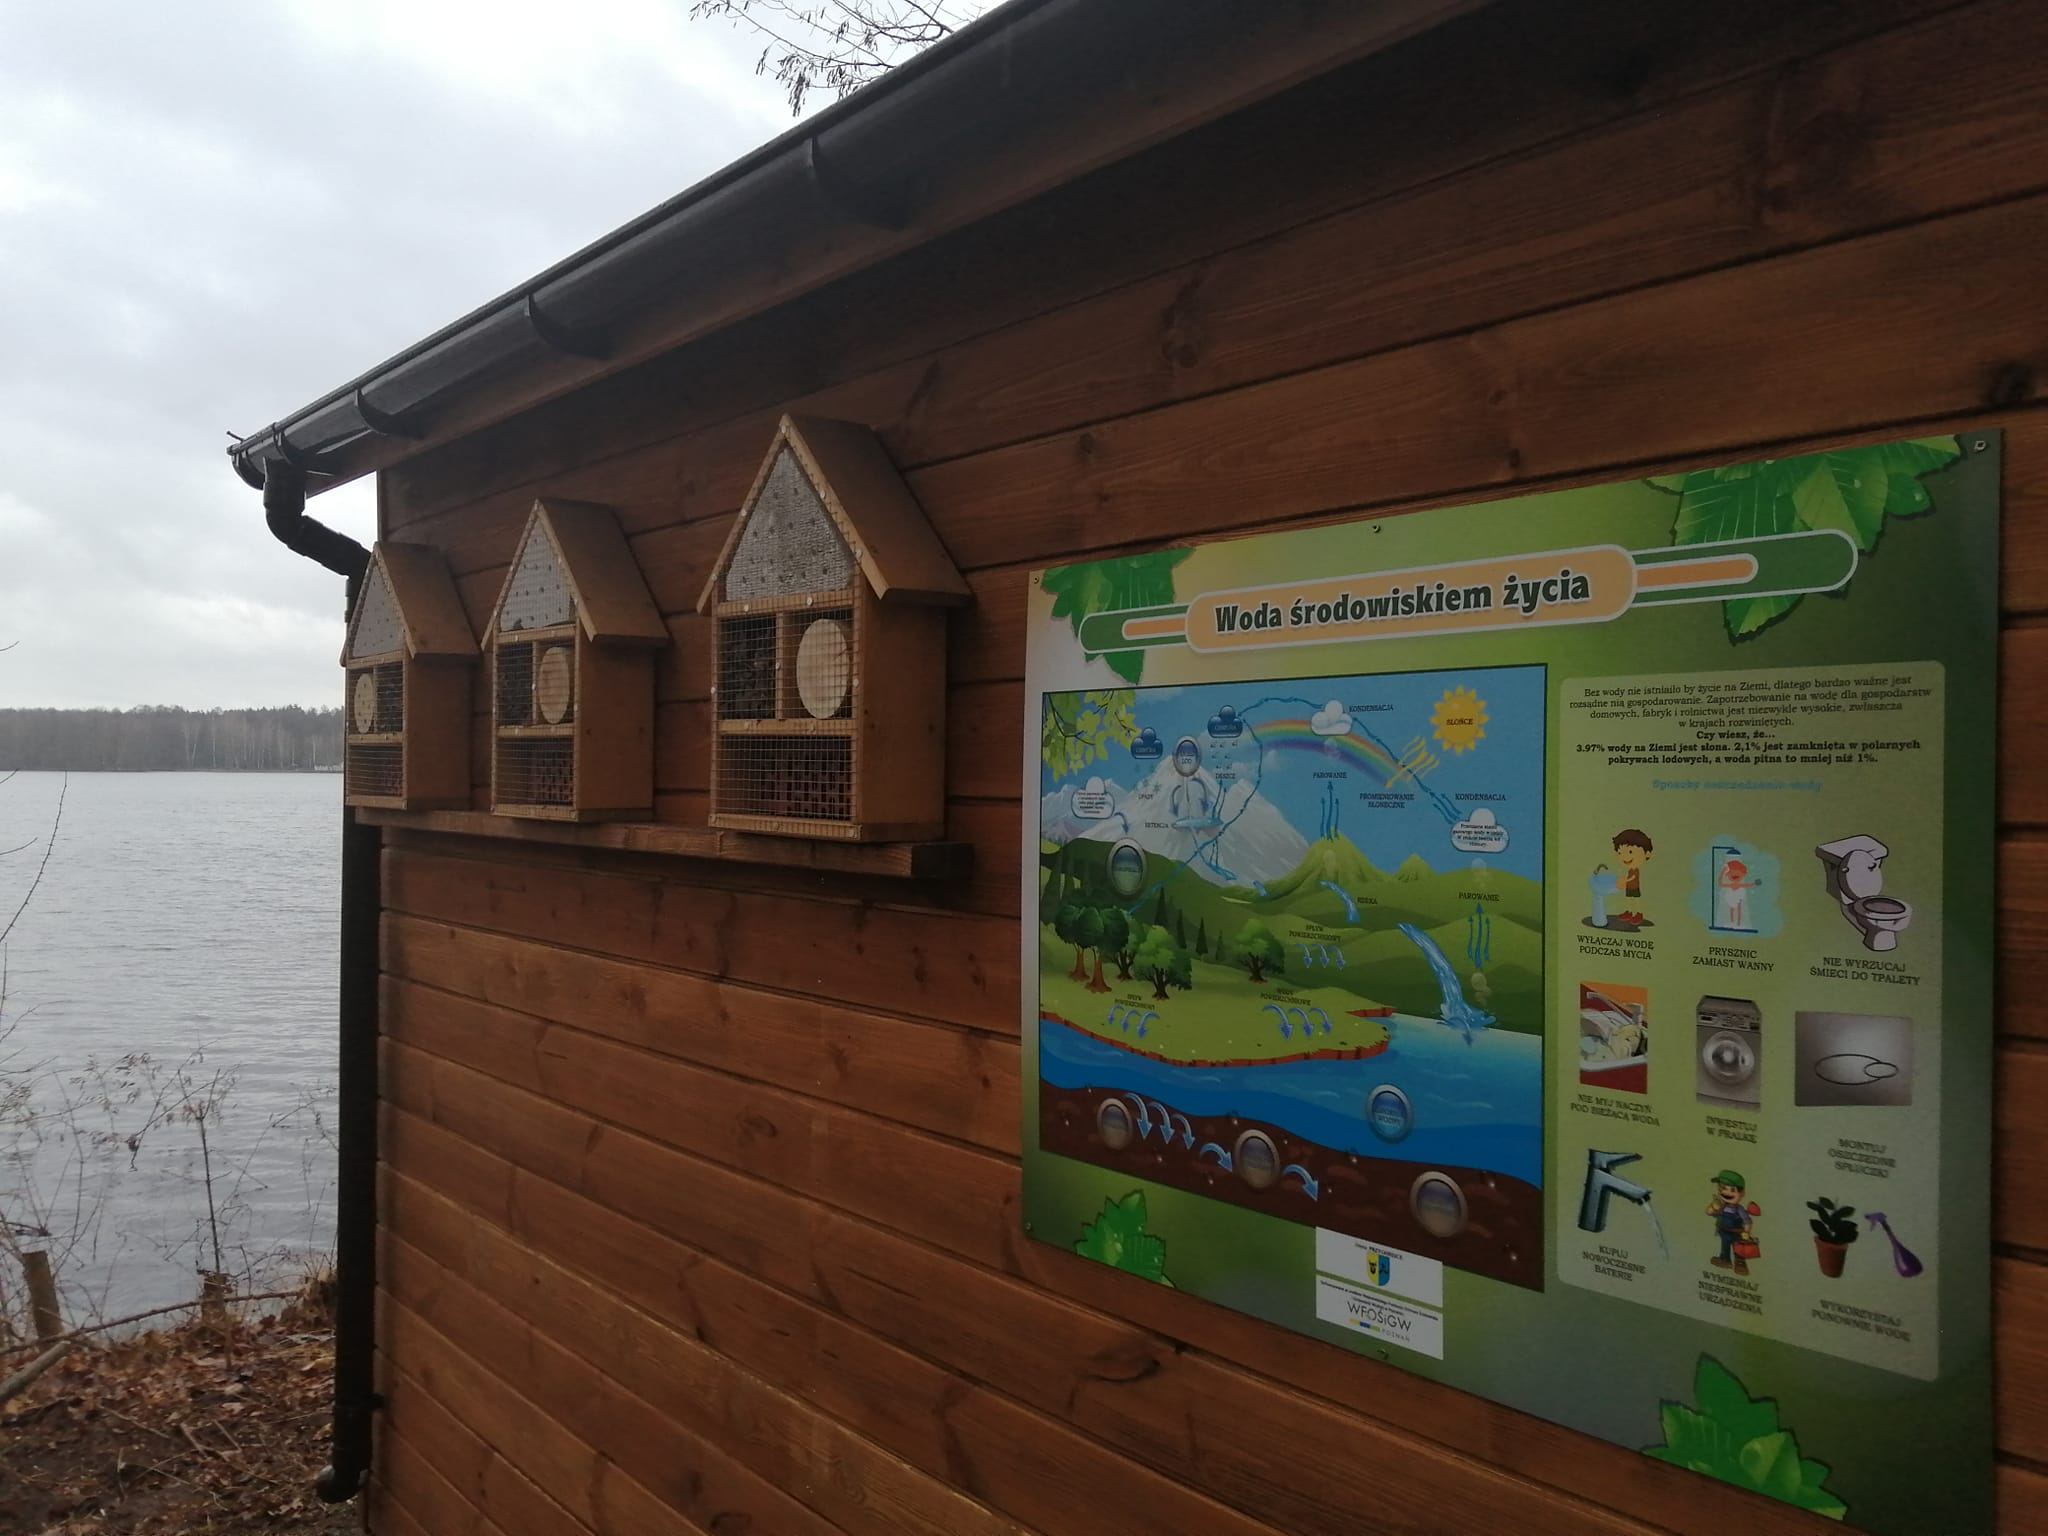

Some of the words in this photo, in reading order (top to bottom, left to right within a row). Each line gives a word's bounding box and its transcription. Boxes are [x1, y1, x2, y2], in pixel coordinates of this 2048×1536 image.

[1215, 601, 1282, 632] Woda
[1290, 582, 1492, 626] środowiskiem
[1502, 569, 1591, 613] życia
[1584, 687, 1600, 697] Bez
[1602, 686, 1626, 698] wody
[1627, 685, 1641, 696] nie
[1683, 683, 1696, 695] by
[1724, 683, 1737, 692] na
[1740, 681, 1772, 692] Ziemi,
[1773, 679, 1812, 692] dlatego
[1814, 678, 1850, 689] bardzo
[1890, 675, 1912, 688] jest
[1706, 692, 1791, 706] Zapotrzebowanie
[1794, 692, 1808, 701] na
[1840, 689, 1858, 700] dla
[1860, 687, 1933, 701] gospodarstw
[1349, 704, 1394, 713] KONDENSACJA
[1642, 707, 1672, 720] fabryk
[1680, 706, 1725, 717] rolnictwa
[1726, 704, 1746, 717] jest
[1748, 702, 1798, 715] niezwykle
[1678, 720, 1687, 728] w
[1689, 717, 1725, 730] krajach
[1696, 730, 1716, 741] Czy
[1718, 730, 1750, 741] wiesz,
[1576, 744, 1605, 753] 3.97%
[1607, 743, 1632, 754] wody
[1634, 744, 1646, 752] na
[1648, 742, 1677, 752] Ziemi
[1678, 742, 1699, 754] jest
[1734, 741, 1763, 753] 2,1%
[1763, 740, 1784, 753] jest
[1787, 740, 1846, 752] zamknięta
[1848, 741, 1858, 749] w
[1861, 739, 1921, 751] polarnych
[1608, 754, 1659, 766] pokrywach
[1662, 753, 1712, 766] lodowych,
[1724, 754, 1751, 763] woda
[1754, 753, 1782, 765] pitna
[1785, 754, 1797, 763] to
[1800, 753, 1832, 765] mniej
[1312, 771, 1347, 779] PAROWANIE
[1455, 793, 1506, 801] KONDENSACJA
[1458, 891, 1500, 902] PAROWANIE
[1579, 945, 1621, 957] PODCZAS
[1622, 949, 1652, 960] MYCIA
[1708, 946, 1757, 959] PRYSZNIC
[1692, 956, 1735, 969] ZAMIAST
[1737, 960, 1774, 972] WANNY
[1822, 956, 1841, 967] NIE
[1844, 958, 1906, 973] WYRZUCAJ
[1809, 966, 1848, 980] ŚMIECI
[1851, 970, 1869, 981] DO
[1570, 1102, 1589, 1113] POD
[1598, 1245, 1629, 1259] KUPUJ
[1582, 1250, 1647, 1274] NOWOCZESNE
